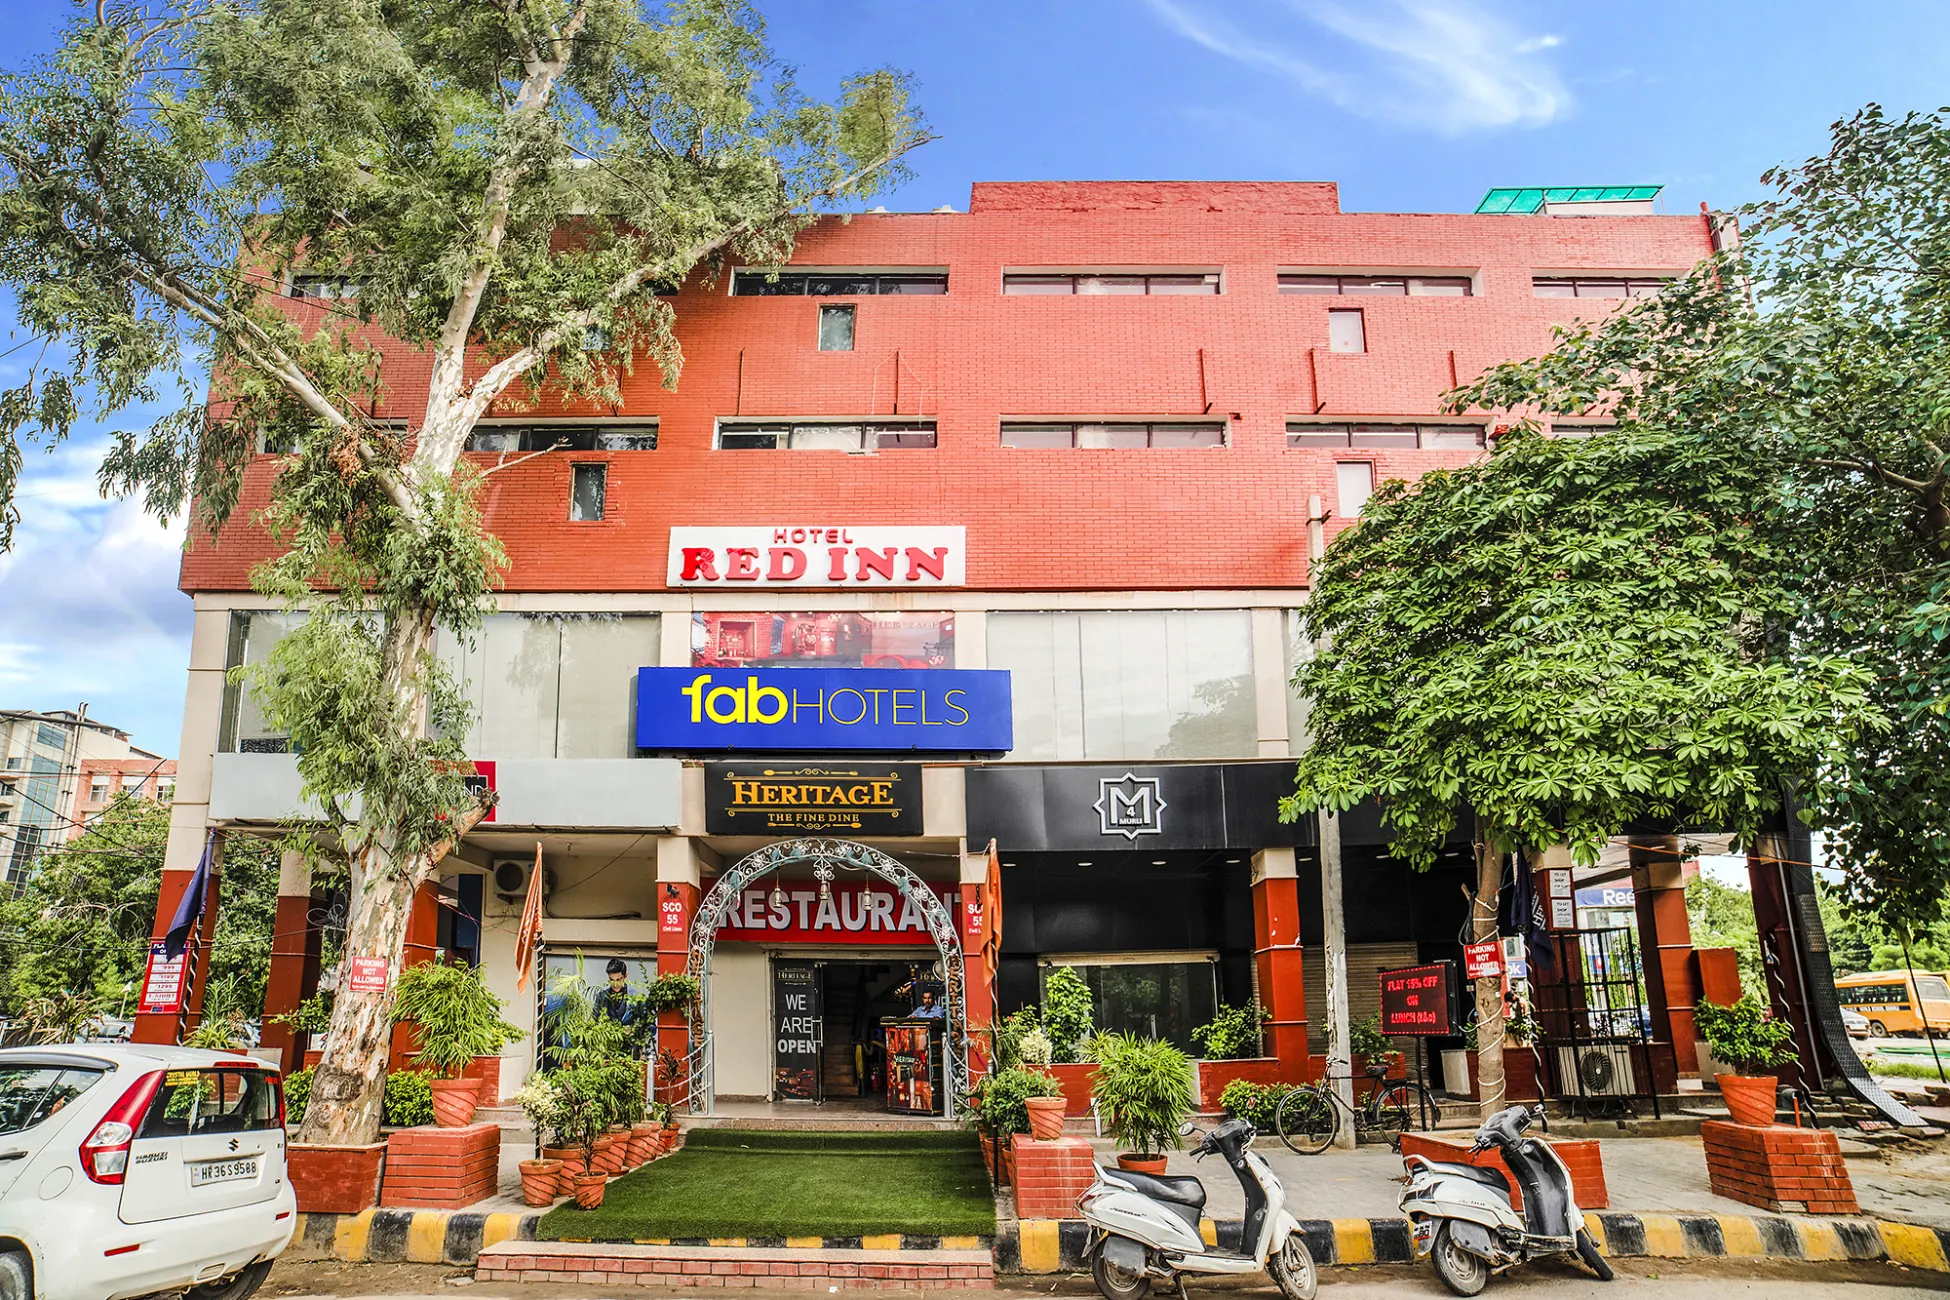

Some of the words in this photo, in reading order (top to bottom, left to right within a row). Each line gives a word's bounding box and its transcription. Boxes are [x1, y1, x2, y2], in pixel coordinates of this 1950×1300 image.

[774, 528, 853, 543] HOTEL
[680, 547, 807, 581] RED
[827, 547, 949, 581] INN
[732, 781, 894, 805] HERITAGE
[1126, 806, 1136, 817] 4
[768, 813, 792, 822] THE
[796, 813, 825, 822] FINE
[829, 813, 860, 823] DINE
[662, 902, 682, 913] SCO
[968, 903, 983, 914] SC
[667, 914, 679, 925] 55
[1467, 944, 1496, 955] PARKING
[1476, 953, 1490, 962] NOT
[355, 959, 385, 968] PARKING
[363, 967, 377, 976] NOT
[353, 975, 385, 985] ALLOWED
[1387, 979, 1406, 992] FLAT
[1422, 975, 1438, 988] OFF
[785, 994, 807, 1010] WE
[1406, 994, 1419, 1006] ON
[1391, 1012, 1416, 1024] LUNCH
[780, 1016, 812, 1034] ARE
[777, 1039, 817, 1054] OPEN
[135, 1156, 168, 1165] SUZUKI
